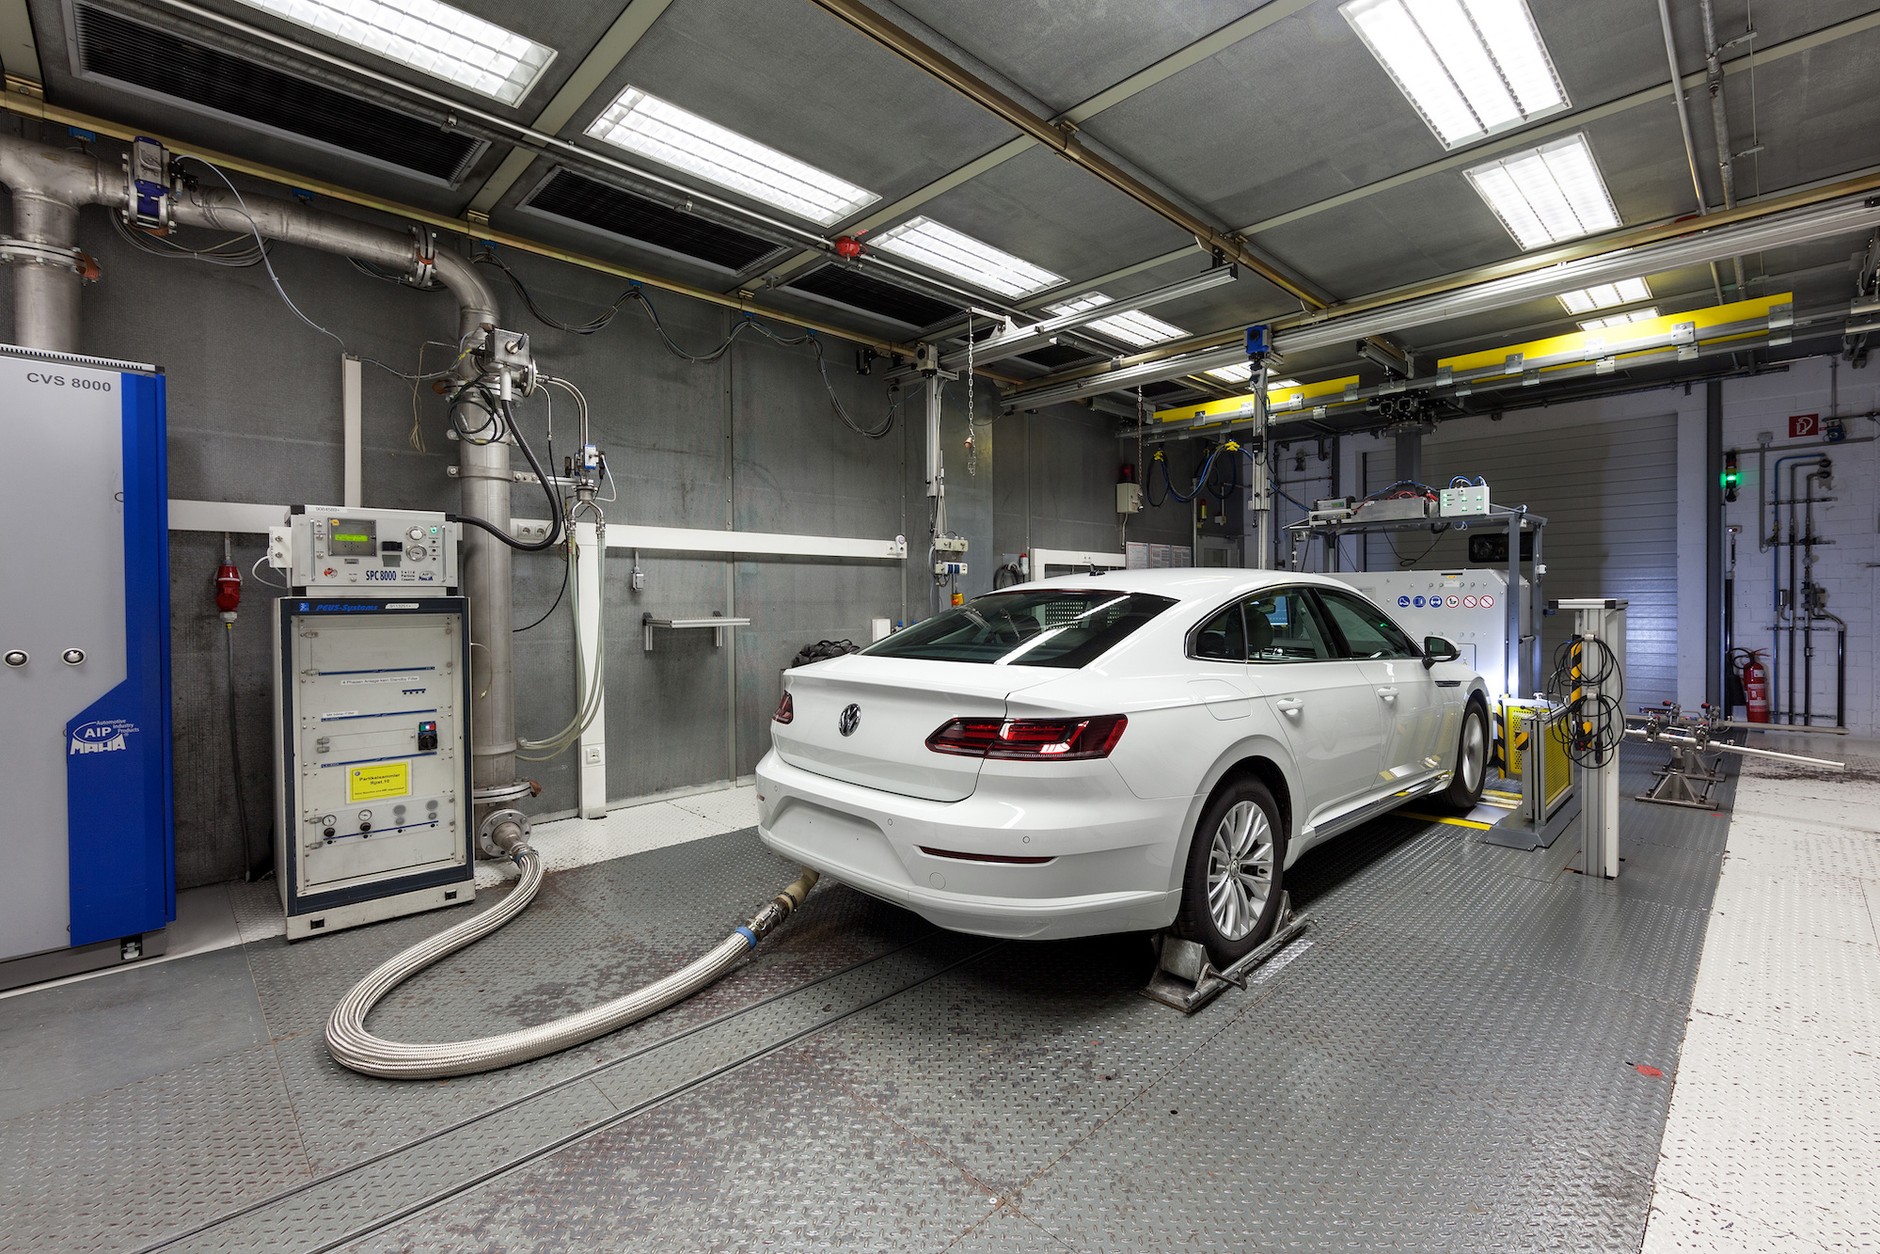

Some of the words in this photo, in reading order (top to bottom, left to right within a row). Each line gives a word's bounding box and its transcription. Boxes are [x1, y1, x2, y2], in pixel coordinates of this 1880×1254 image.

[27, 372, 65, 386] CVS
[71, 378, 111, 392] 8000
[365, 570, 379, 581] SPC
[380, 570, 397, 581] 8000
[84, 727, 112, 738] AIP
[70, 733, 126, 755] MAHA
